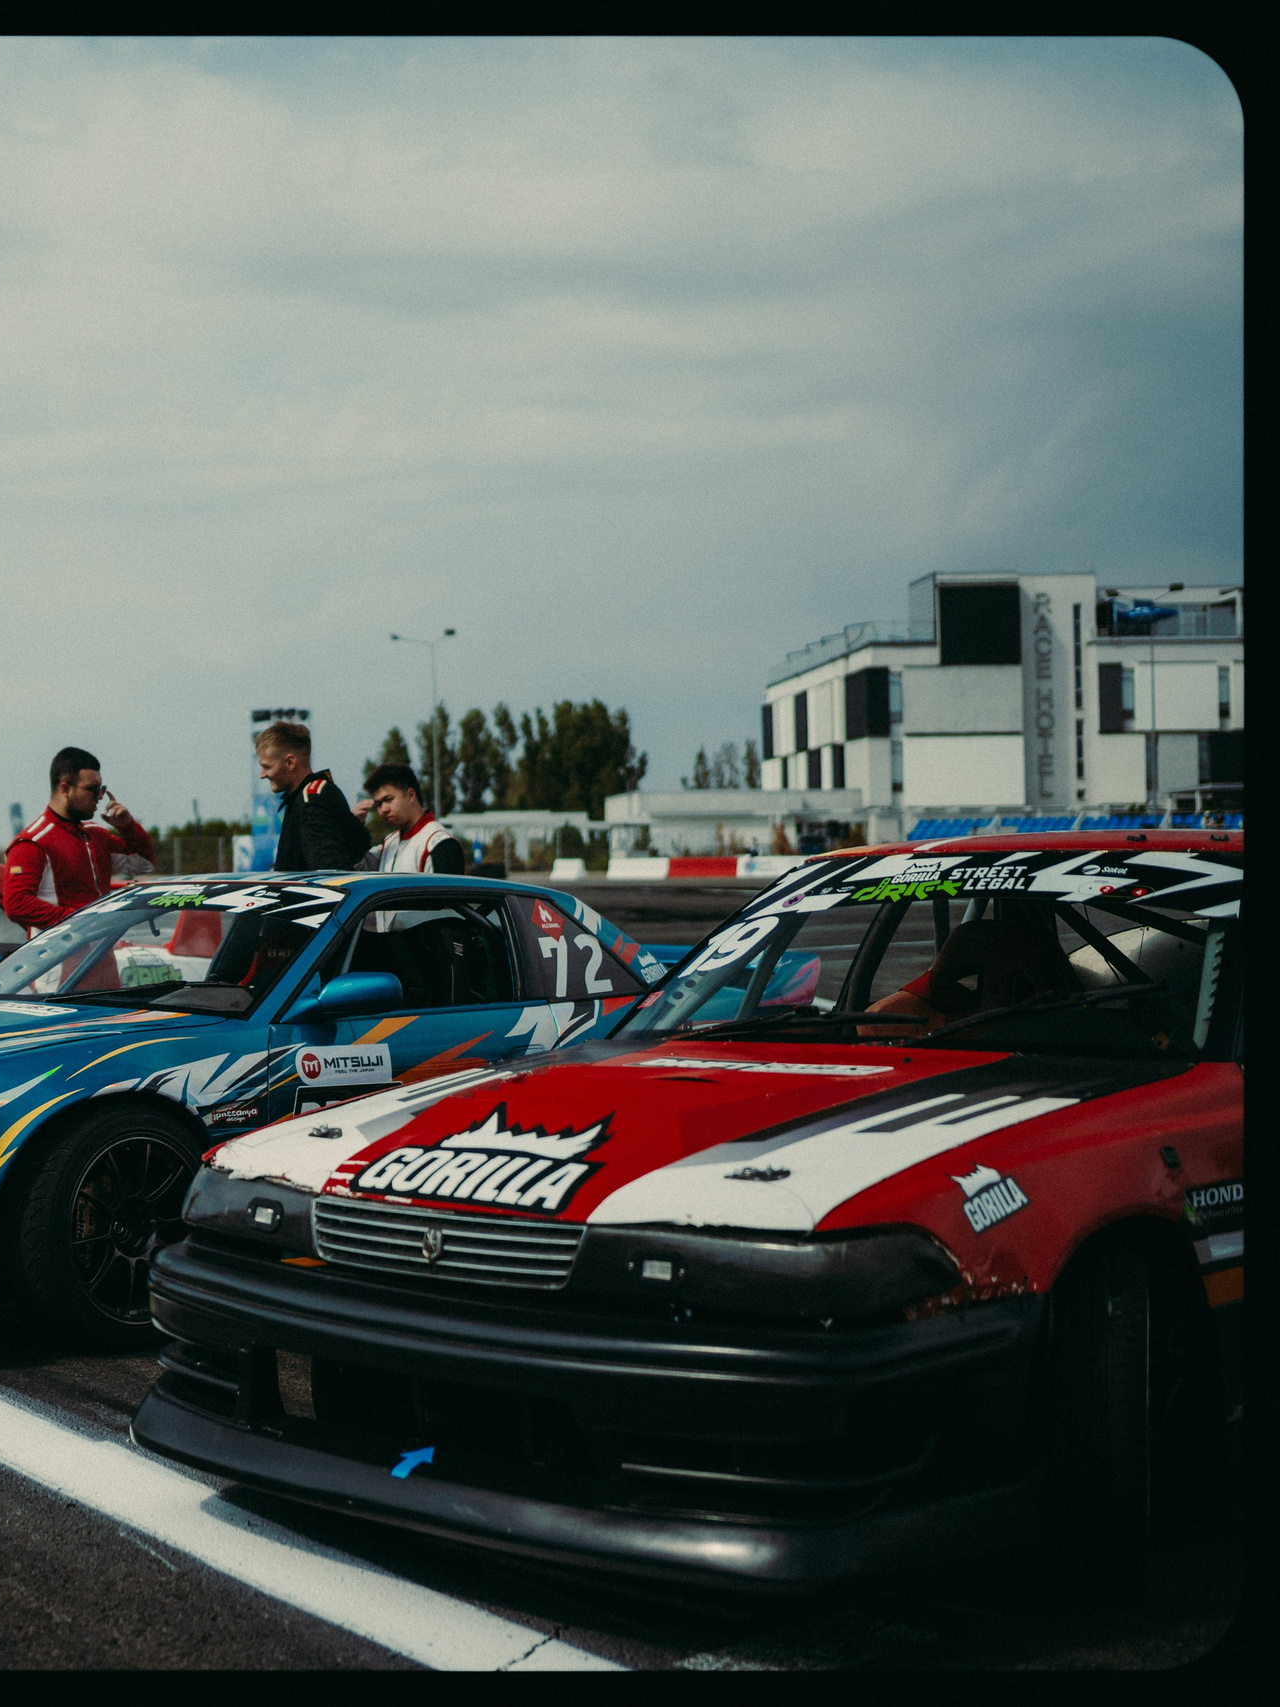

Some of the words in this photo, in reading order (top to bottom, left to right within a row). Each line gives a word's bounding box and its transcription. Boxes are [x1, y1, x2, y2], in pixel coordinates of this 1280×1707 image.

[1034, 592, 1052, 680] RACE
[1035, 687, 1055, 798] HOTEL
[891, 871, 941, 884] GORILLA
[948, 866, 1028, 880] STREET
[963, 878, 1026, 891] LEGAL
[537, 933, 613, 997] 72
[677, 916, 780, 979] 19
[323, 1055, 384, 1069] MITSUJI
[358, 1147, 589, 1210] GORILLA
[963, 1177, 1029, 1233] GORILLA
